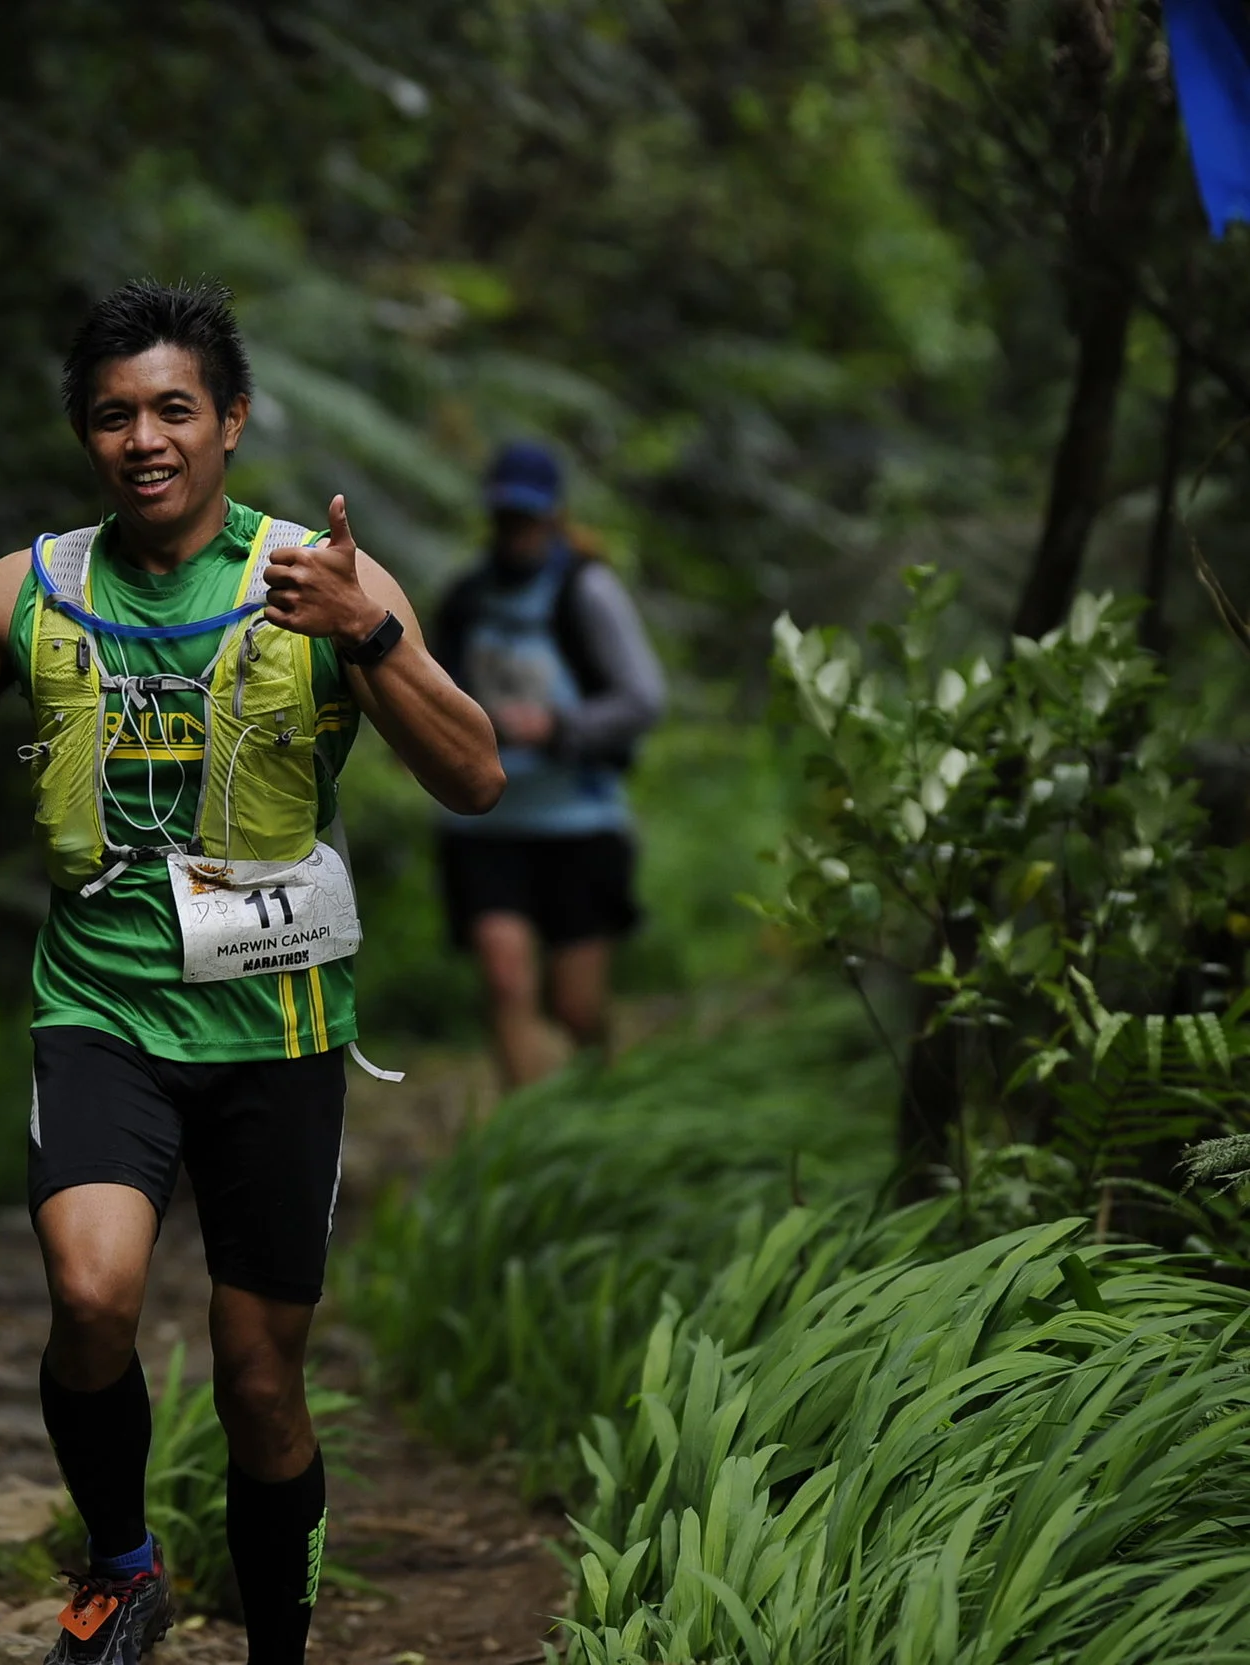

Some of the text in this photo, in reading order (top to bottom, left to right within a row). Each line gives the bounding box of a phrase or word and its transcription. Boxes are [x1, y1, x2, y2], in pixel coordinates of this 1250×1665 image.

[244, 885, 293, 929] 11
[217, 925, 331, 958] MARWIN CANAPI
[243, 949, 310, 972] MARATHON
